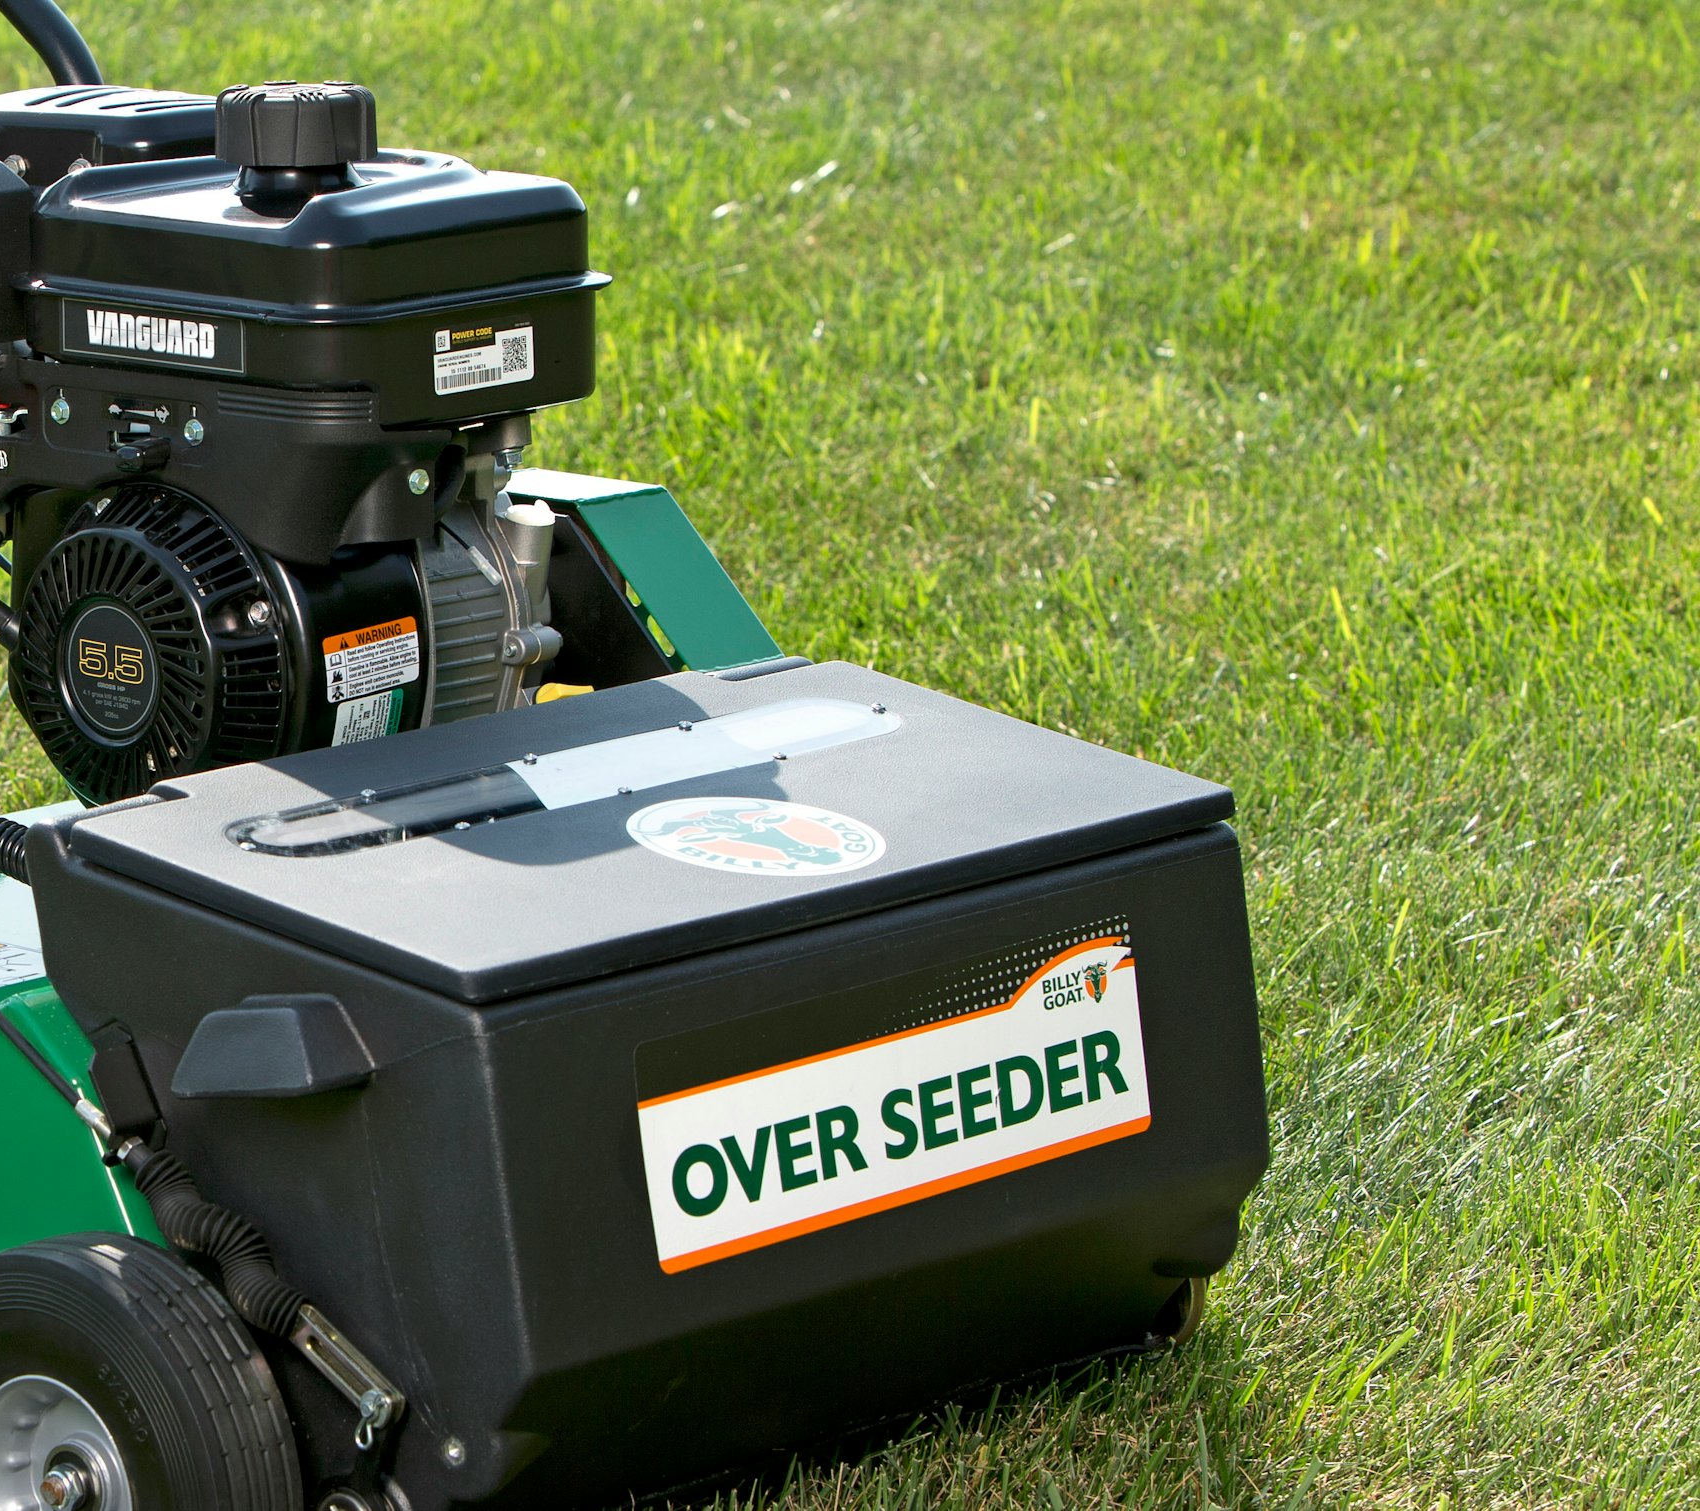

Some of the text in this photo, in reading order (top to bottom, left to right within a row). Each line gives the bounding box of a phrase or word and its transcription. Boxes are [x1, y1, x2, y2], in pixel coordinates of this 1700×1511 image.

[86, 309, 215, 359] VANGUARD
[452, 326, 492, 340] POWER CODE
[356, 623, 401, 644] WARNING
[360, 652, 374, 661] running
[380, 646, 396, 655] servicing
[376, 640, 394, 650] Operating
[399, 652, 411, 660] engine
[79, 638, 143, 685] 5.5
[97, 681, 117, 691] GROSS
[349, 682, 364, 690] Engines
[813, 815, 867, 853] GOAT
[677, 846, 803, 870] BILLY
[1042, 970, 1081, 994] BILLY
[1044, 987, 1083, 1010] GOAT
[671, 1030, 1129, 1217] OVER SEEDER
